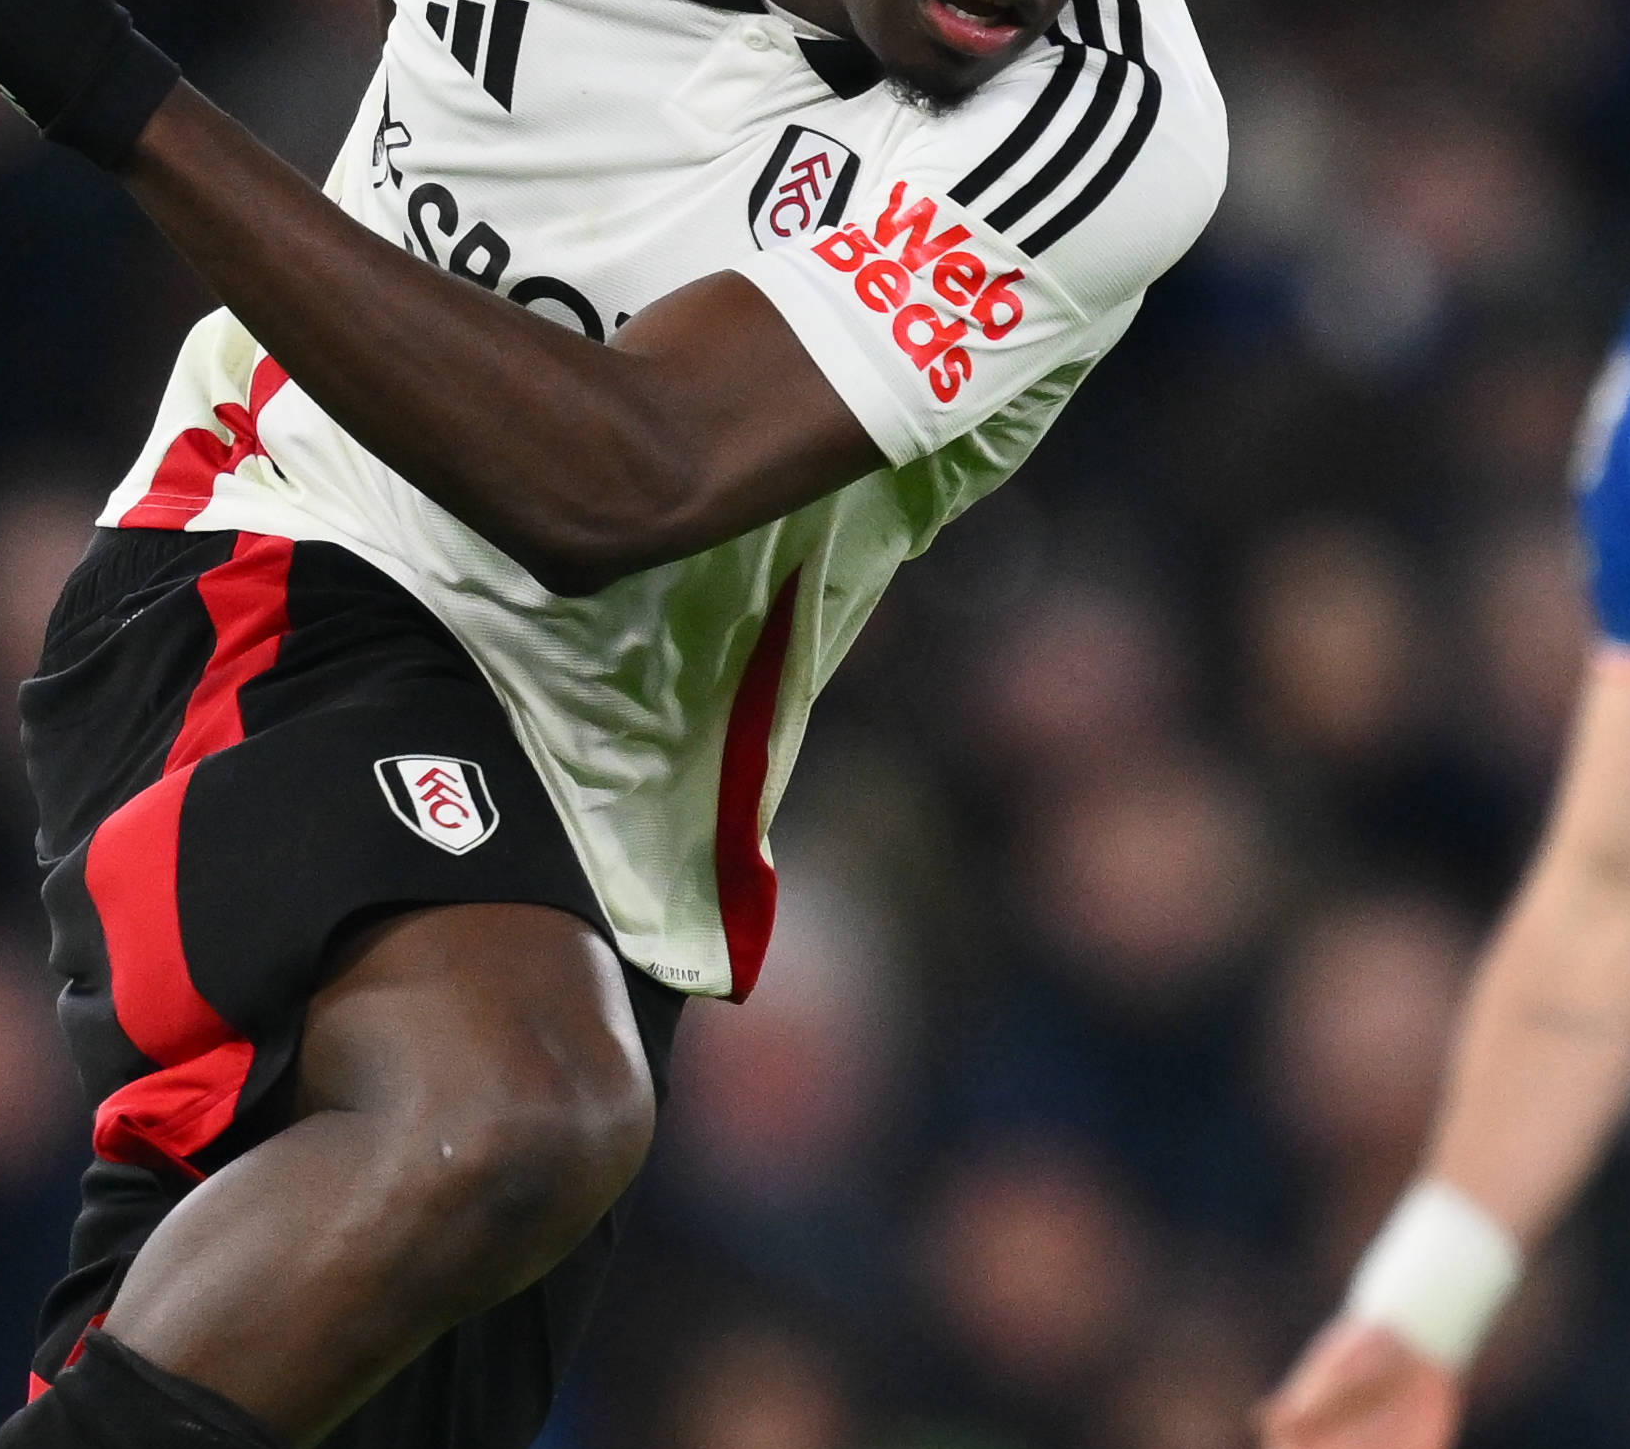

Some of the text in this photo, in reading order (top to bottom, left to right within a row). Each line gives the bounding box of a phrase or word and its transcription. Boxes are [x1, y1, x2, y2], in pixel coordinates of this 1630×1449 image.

[759, 151, 832, 237] FFC
[810, 222, 972, 403] Beds
[873, 180, 1025, 340] Web
[415, 767, 469, 829] FFC
